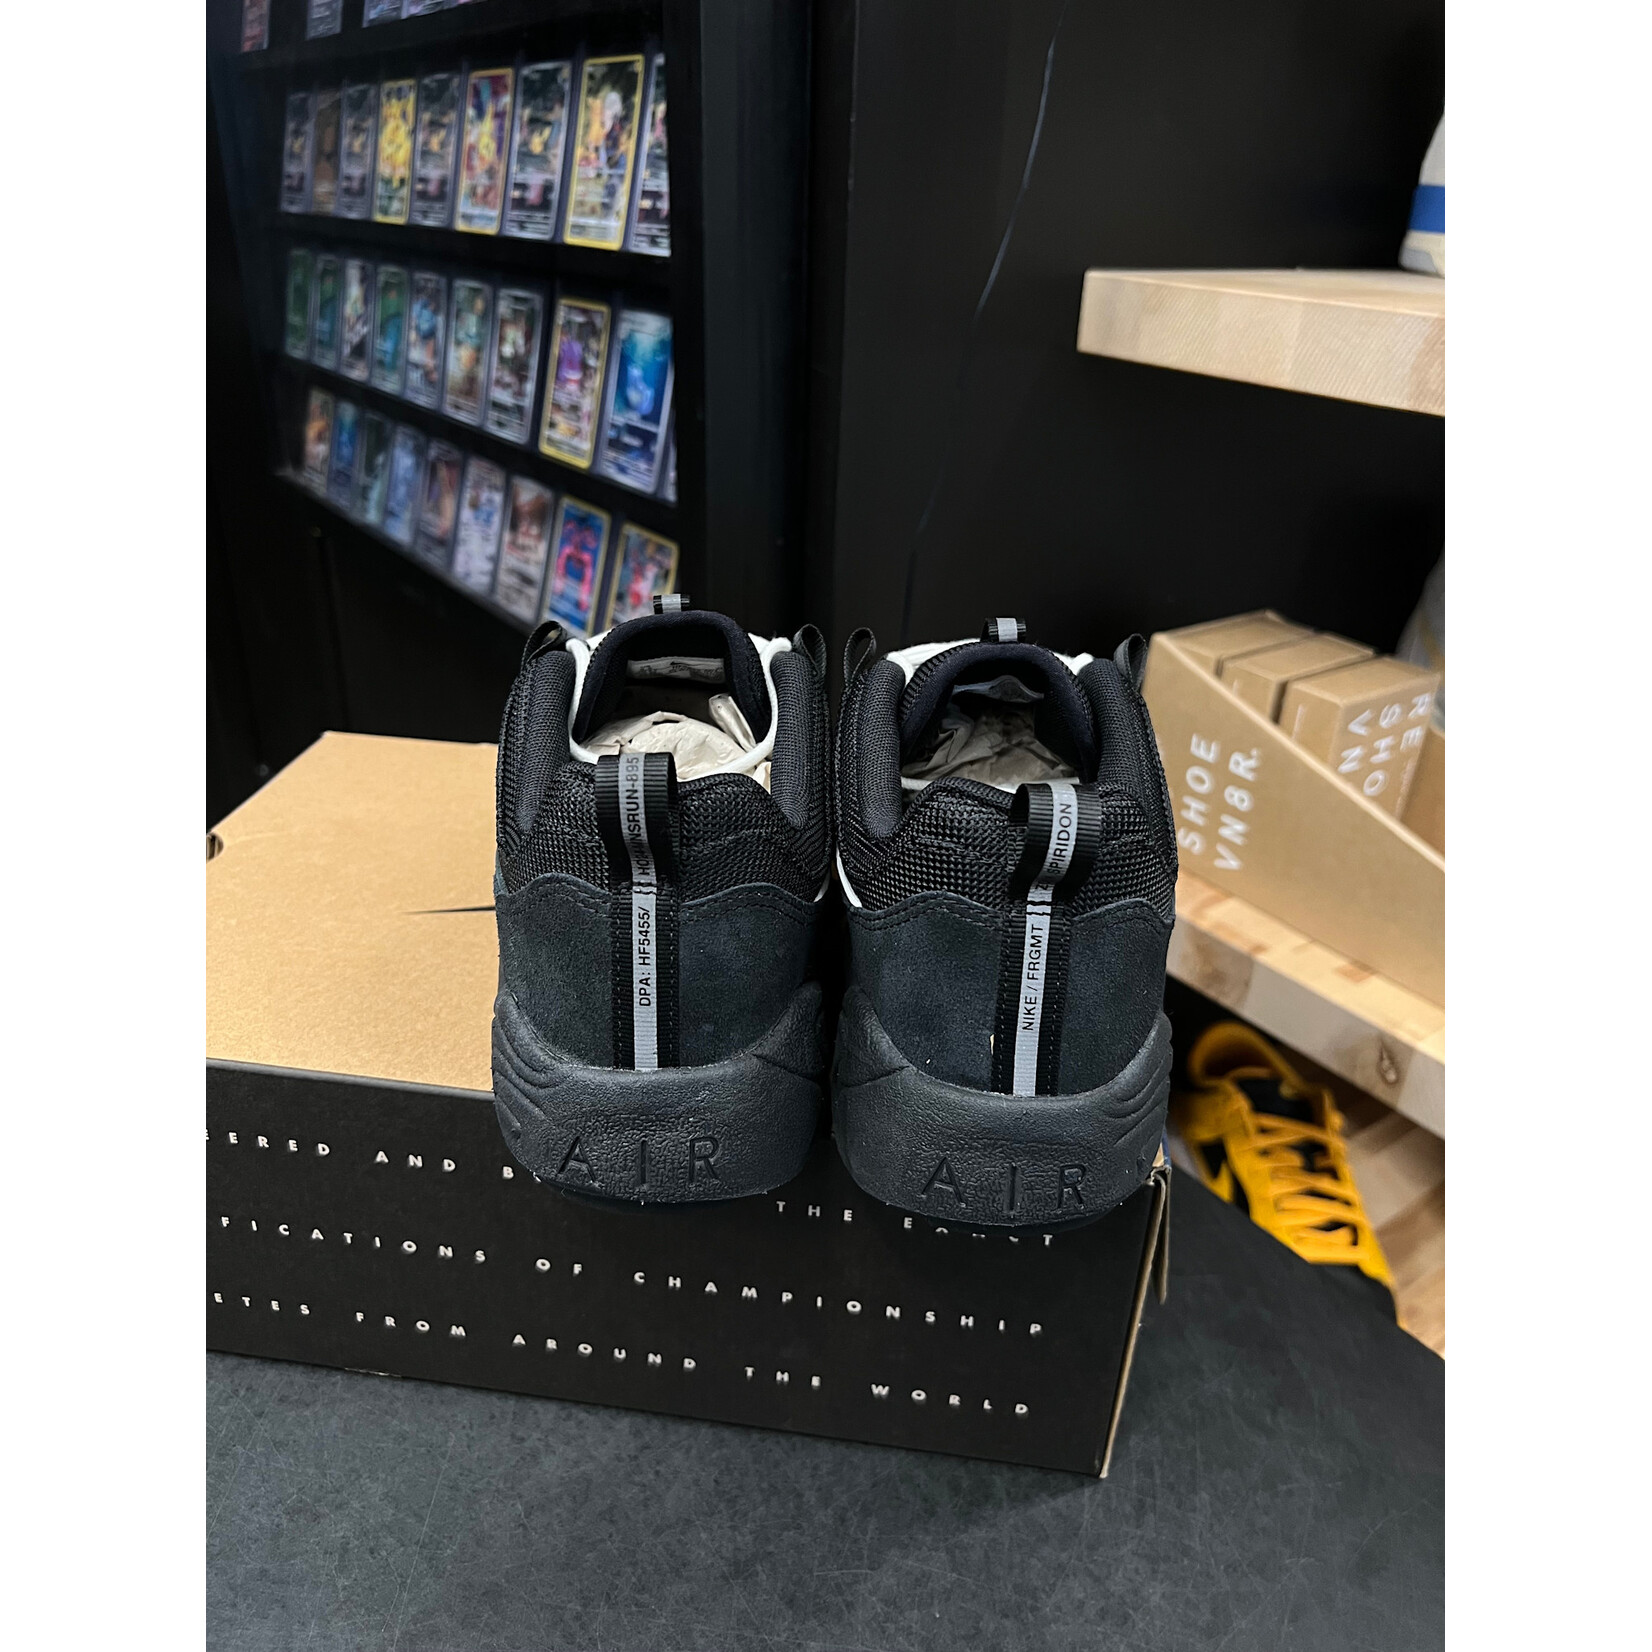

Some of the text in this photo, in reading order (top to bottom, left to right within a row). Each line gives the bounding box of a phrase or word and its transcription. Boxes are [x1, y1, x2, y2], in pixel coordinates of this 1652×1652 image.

[1178, 732, 1220, 854] SHOE
[637, 906, 651, 1007] DPA: HF5455/
[1026, 923, 1044, 981] FRGMT
[1021, 995, 1037, 1031] NIKE
[375, 1150, 456, 1172] AND
[776, 1201, 853, 1222] THE
[556, 1135, 721, 1185] AIR
[921, 1156, 1087, 1211] AIR
[221, 1216, 1042, 1335] FICATIONS OF CHAMPIONSHIP
[213, 1292, 1029, 1415] ETES FROM AROUND THE WORLD
